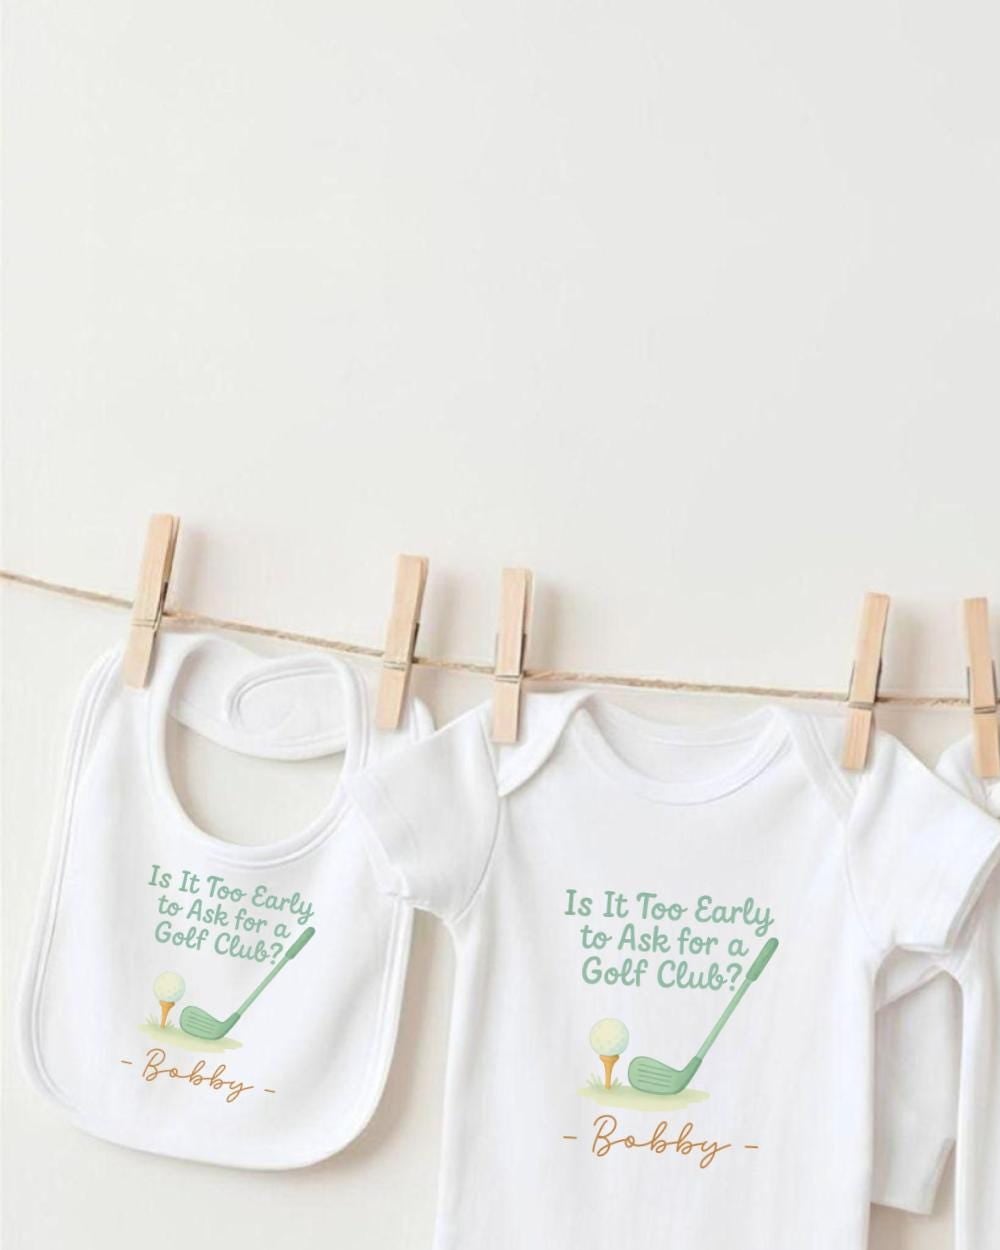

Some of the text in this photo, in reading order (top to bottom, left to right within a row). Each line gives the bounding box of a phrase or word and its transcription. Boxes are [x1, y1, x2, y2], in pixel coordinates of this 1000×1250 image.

[148, 864, 315, 925] Is It Too Early
[158, 895, 291, 939] to Ask for a
[564, 889, 775, 937] Is It Too Early
[155, 921, 283, 965] Golf Club?
[580, 923, 749, 957] to Ask for a
[581, 956, 743, 991] Golf Club?
[142, 1048, 254, 1103] Bobby
[592, 1114, 732, 1169] Bobby
